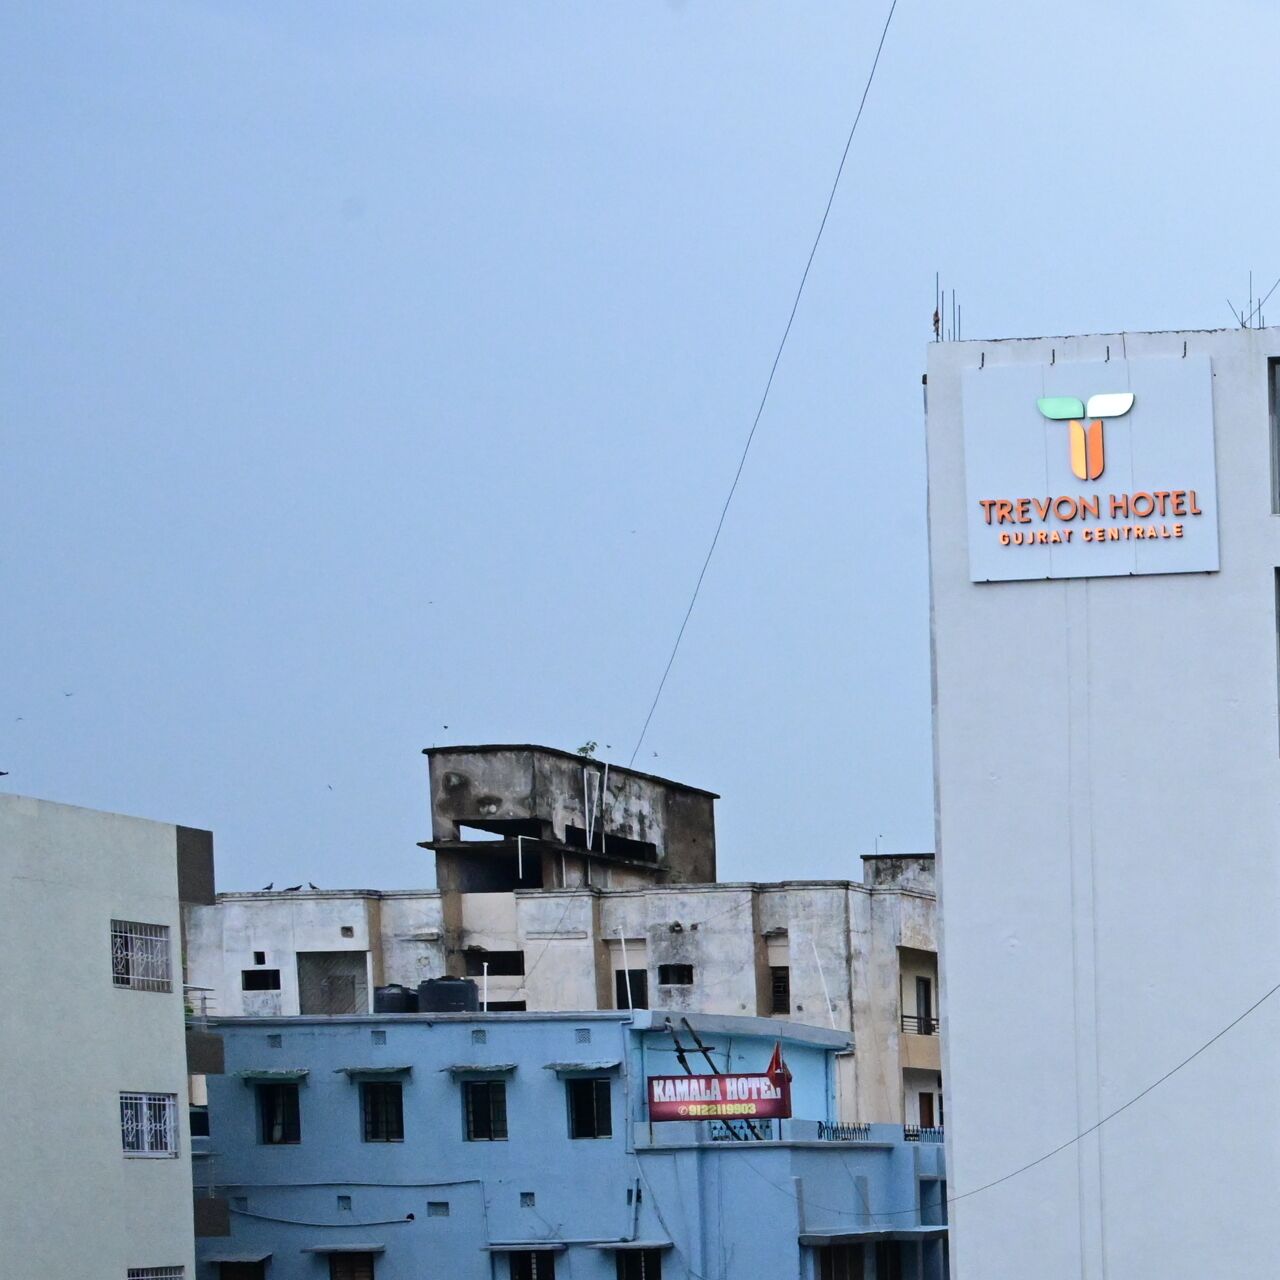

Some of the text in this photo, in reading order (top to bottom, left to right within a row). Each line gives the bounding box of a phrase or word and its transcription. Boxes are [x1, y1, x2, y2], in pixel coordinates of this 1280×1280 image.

[979, 489, 1203, 525] TREVON HOTEL
[999, 524, 1185, 547] GUJRAT CENTRALE
[652, 1078, 722, 1103] KAMALA
